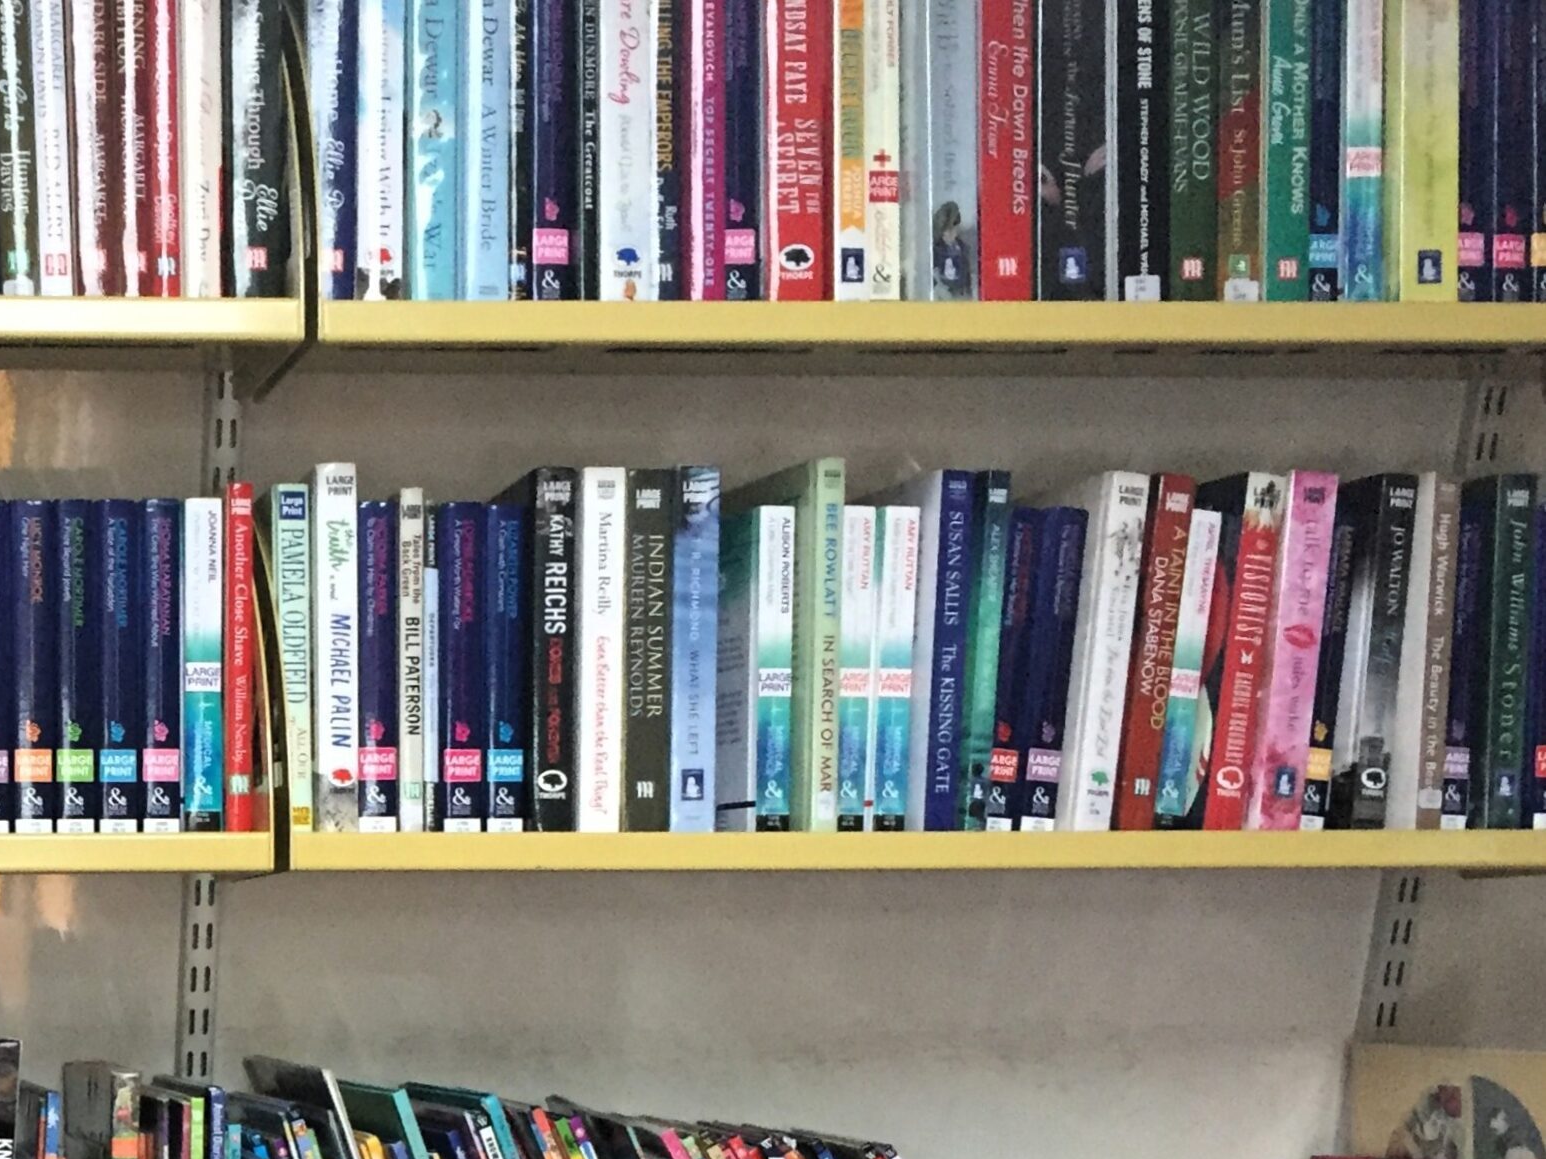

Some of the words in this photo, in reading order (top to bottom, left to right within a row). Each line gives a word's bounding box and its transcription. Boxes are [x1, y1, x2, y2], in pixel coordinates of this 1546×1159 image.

[608, 27, 641, 105] Dowling
[784, 61, 807, 104] FAYE
[1137, 47, 1152, 89] STONE
[585, 109, 596, 137] The
[1012, 84, 1027, 140] Dawn
[1139, 98, 1150, 145] STEPHEN
[1191, 94, 1211, 181] WOOD
[584, 141, 597, 210] Greatcoat
[704, 128, 714, 184] SECRET
[793, 117, 823, 186] SEVEN
[1011, 148, 1028, 216] Breaks
[1139, 147, 1150, 182] GRADY
[704, 192, 715, 288] TWENTY-ONE
[207, 510, 217, 554] JOANNA
[234, 524, 249, 580] Another
[547, 514, 567, 556] KATHY
[597, 512, 613, 571] Martina
[945, 510, 962, 567] SUSAN
[281, 528, 304, 602] PAMELA
[593, 574, 615, 617] Reilly
[630, 533, 646, 621] MAUREEN
[646, 534, 665, 618] INDIAN
[823, 536, 838, 620] ROWLATT
[1152, 557, 1168, 603] DANA
[1388, 546, 1405, 616] WALTON
[234, 583, 248, 622] Close
[543, 561, 569, 635] REICHS
[944, 571, 961, 627] SALLIS
[234, 625, 248, 667] Shave
[281, 608, 309, 706] OLDFIELD
[329, 613, 351, 687] MICHAEL
[404, 616, 418, 651] BILL
[1140, 609, 1161, 696] STABENOW
[405, 654, 421, 737] PATERSON
[629, 625, 646, 718] REYNOLDS
[646, 625, 665, 719] SUMMER
[821, 653, 835, 724] SEARCH
[330, 693, 352, 749] PALIN
[936, 676, 955, 744] KISSING
[935, 747, 951, 794] GATE
